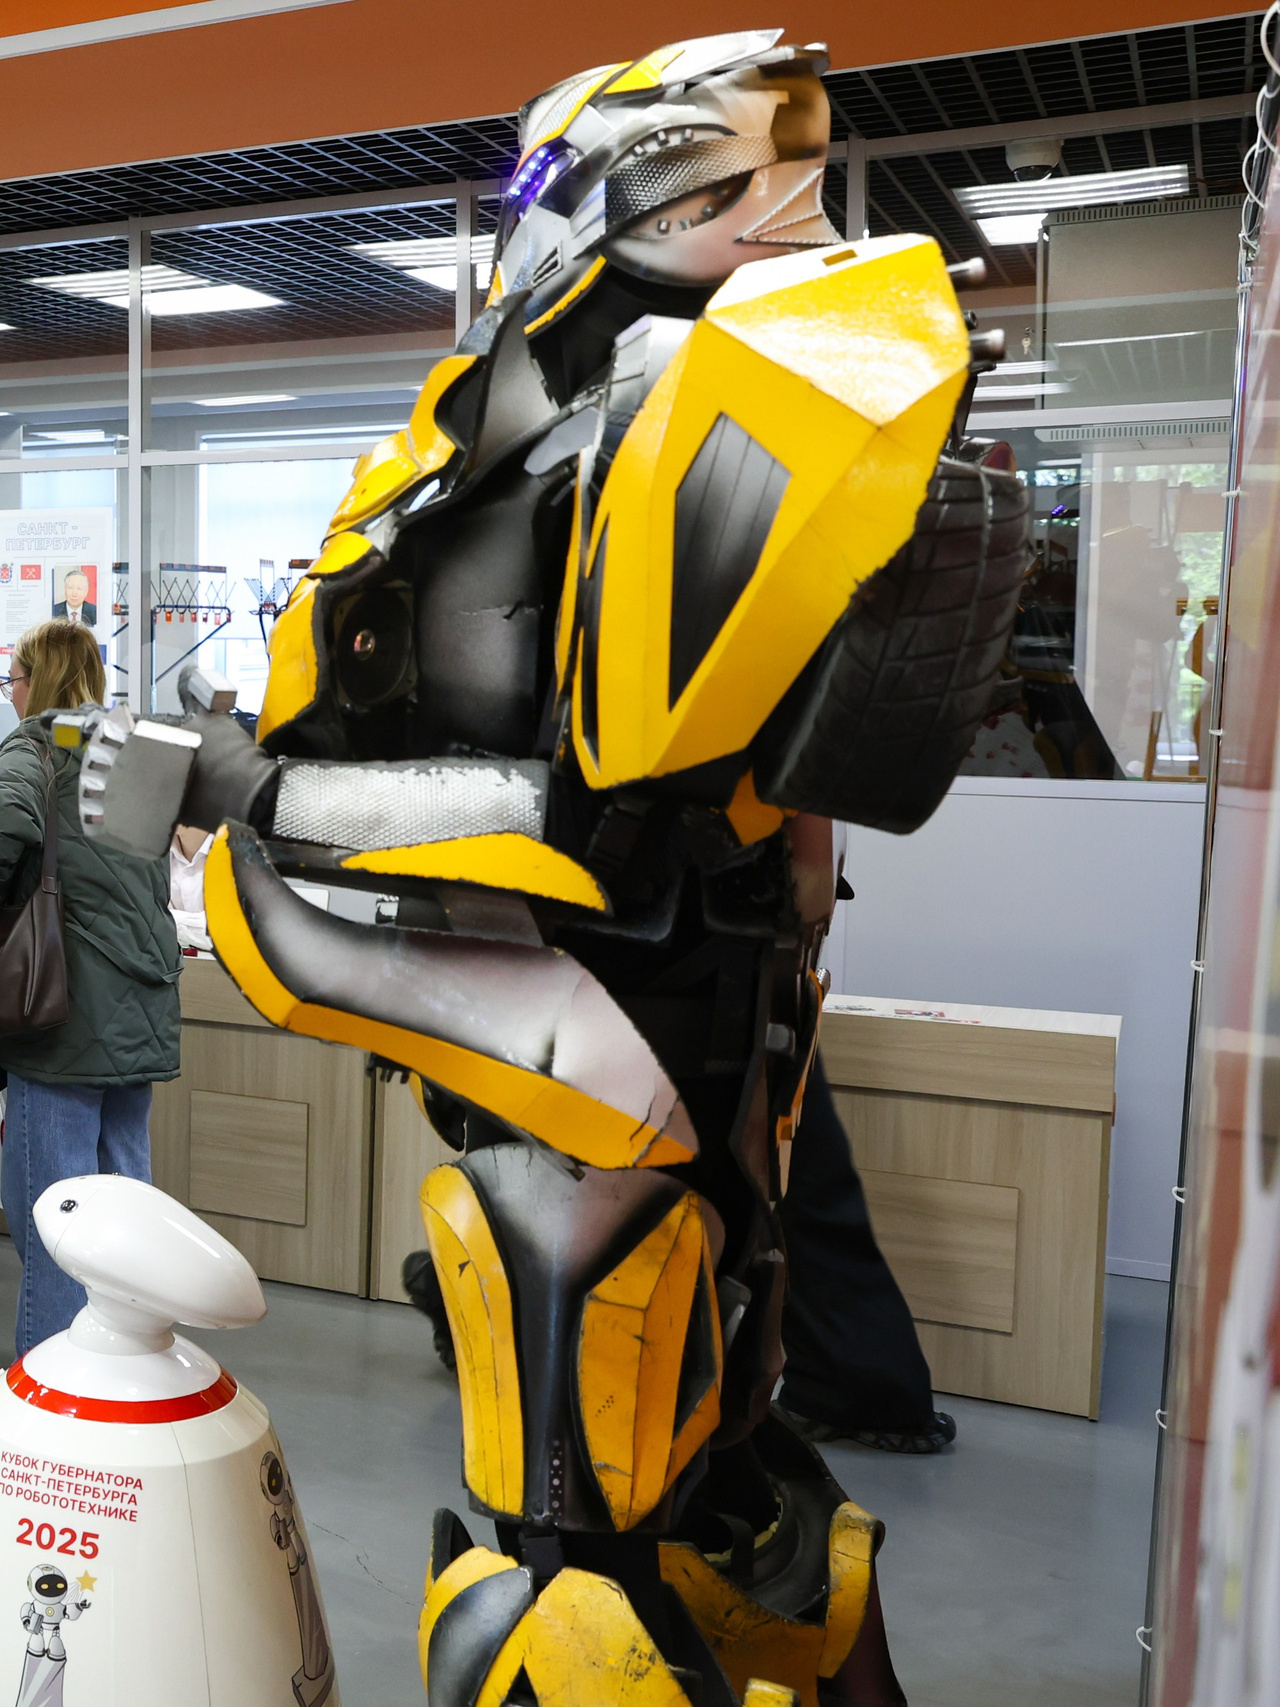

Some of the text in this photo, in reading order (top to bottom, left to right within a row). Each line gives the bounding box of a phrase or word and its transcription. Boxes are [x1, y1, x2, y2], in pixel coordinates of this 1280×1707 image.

[5, 536, 91, 551] ПЕТЕРБУРГ
[17, 521, 69, 536] САНКТ
[1, 1451, 143, 1491] КУБОК ГУБЕРНАТОРА
[1, 1467, 138, 1506] САНКТ-ПЕТЕРБУРГА
[16, 1487, 138, 1522] РОБОТОТЕХНИКЕ
[16, 1518, 99, 1559] 2025
